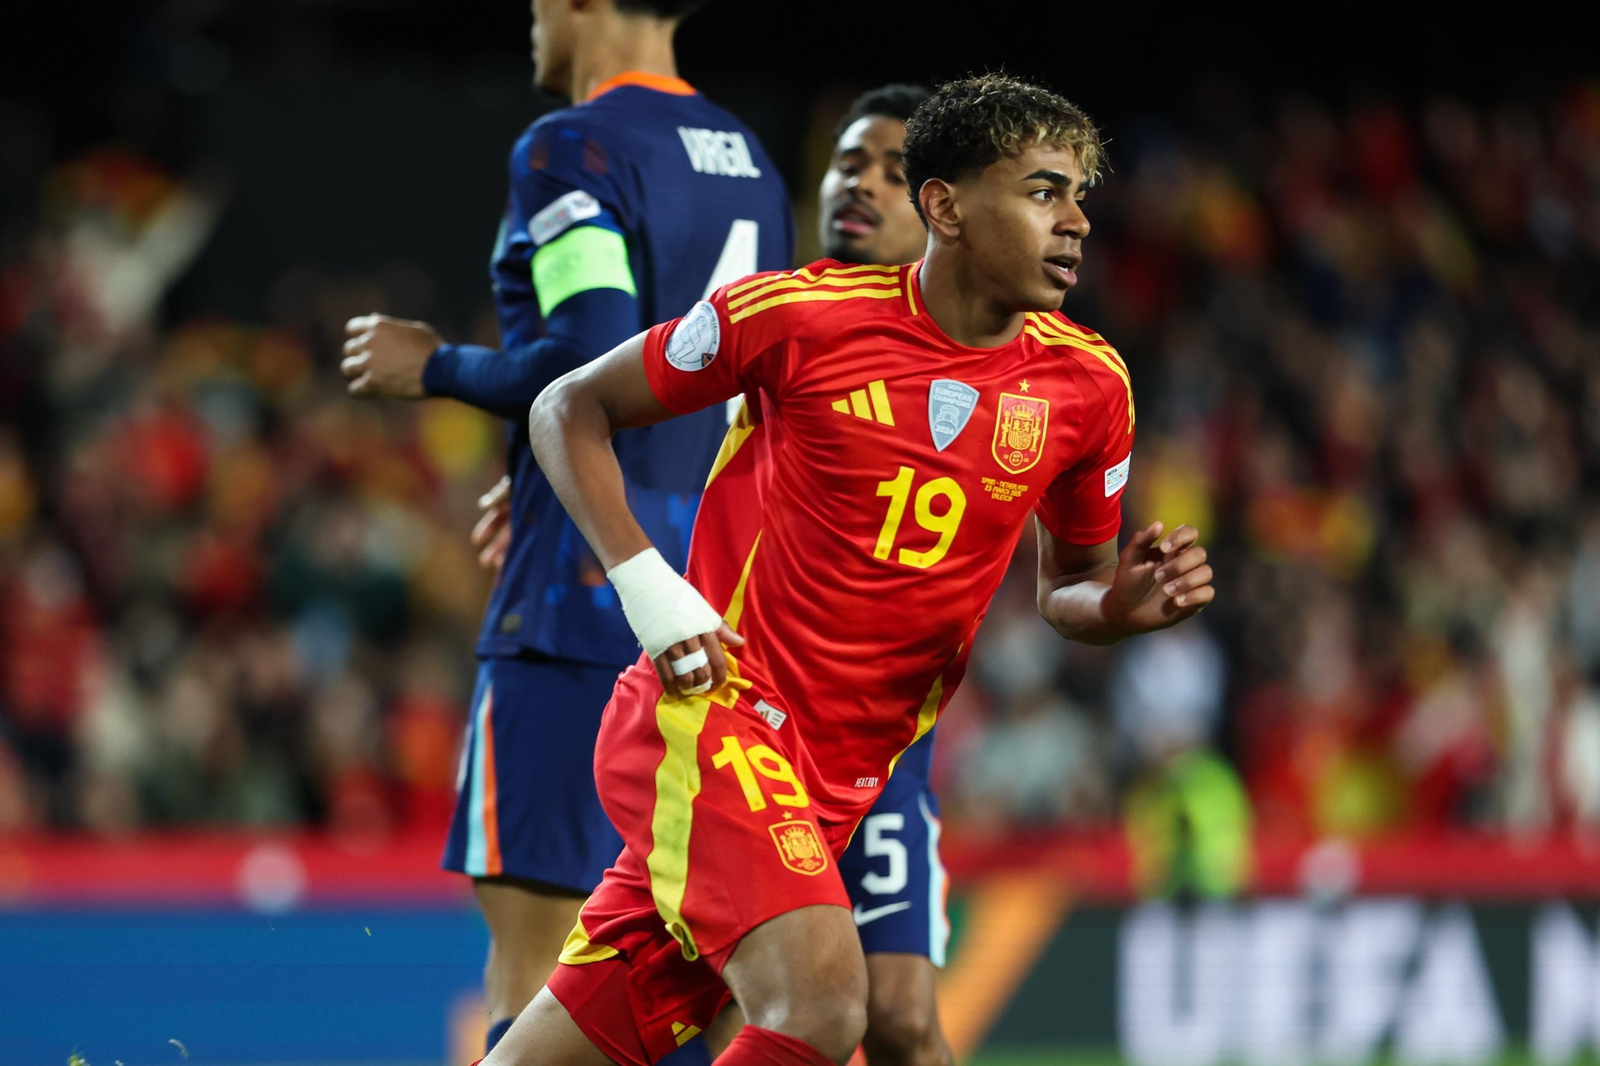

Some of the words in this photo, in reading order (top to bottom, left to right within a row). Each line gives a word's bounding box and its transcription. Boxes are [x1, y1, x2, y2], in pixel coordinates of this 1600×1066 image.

[677, 125, 761, 178] VIRGIL
[933, 394, 971, 409] CHAMPIONS
[934, 387, 974, 402] EUROPEAN
[934, 424, 955, 436] 2024
[873, 465, 967, 569] 19
[711, 735, 810, 812] 19
[861, 812, 908, 895] 5
[1117, 897, 1505, 1066] UEFA
